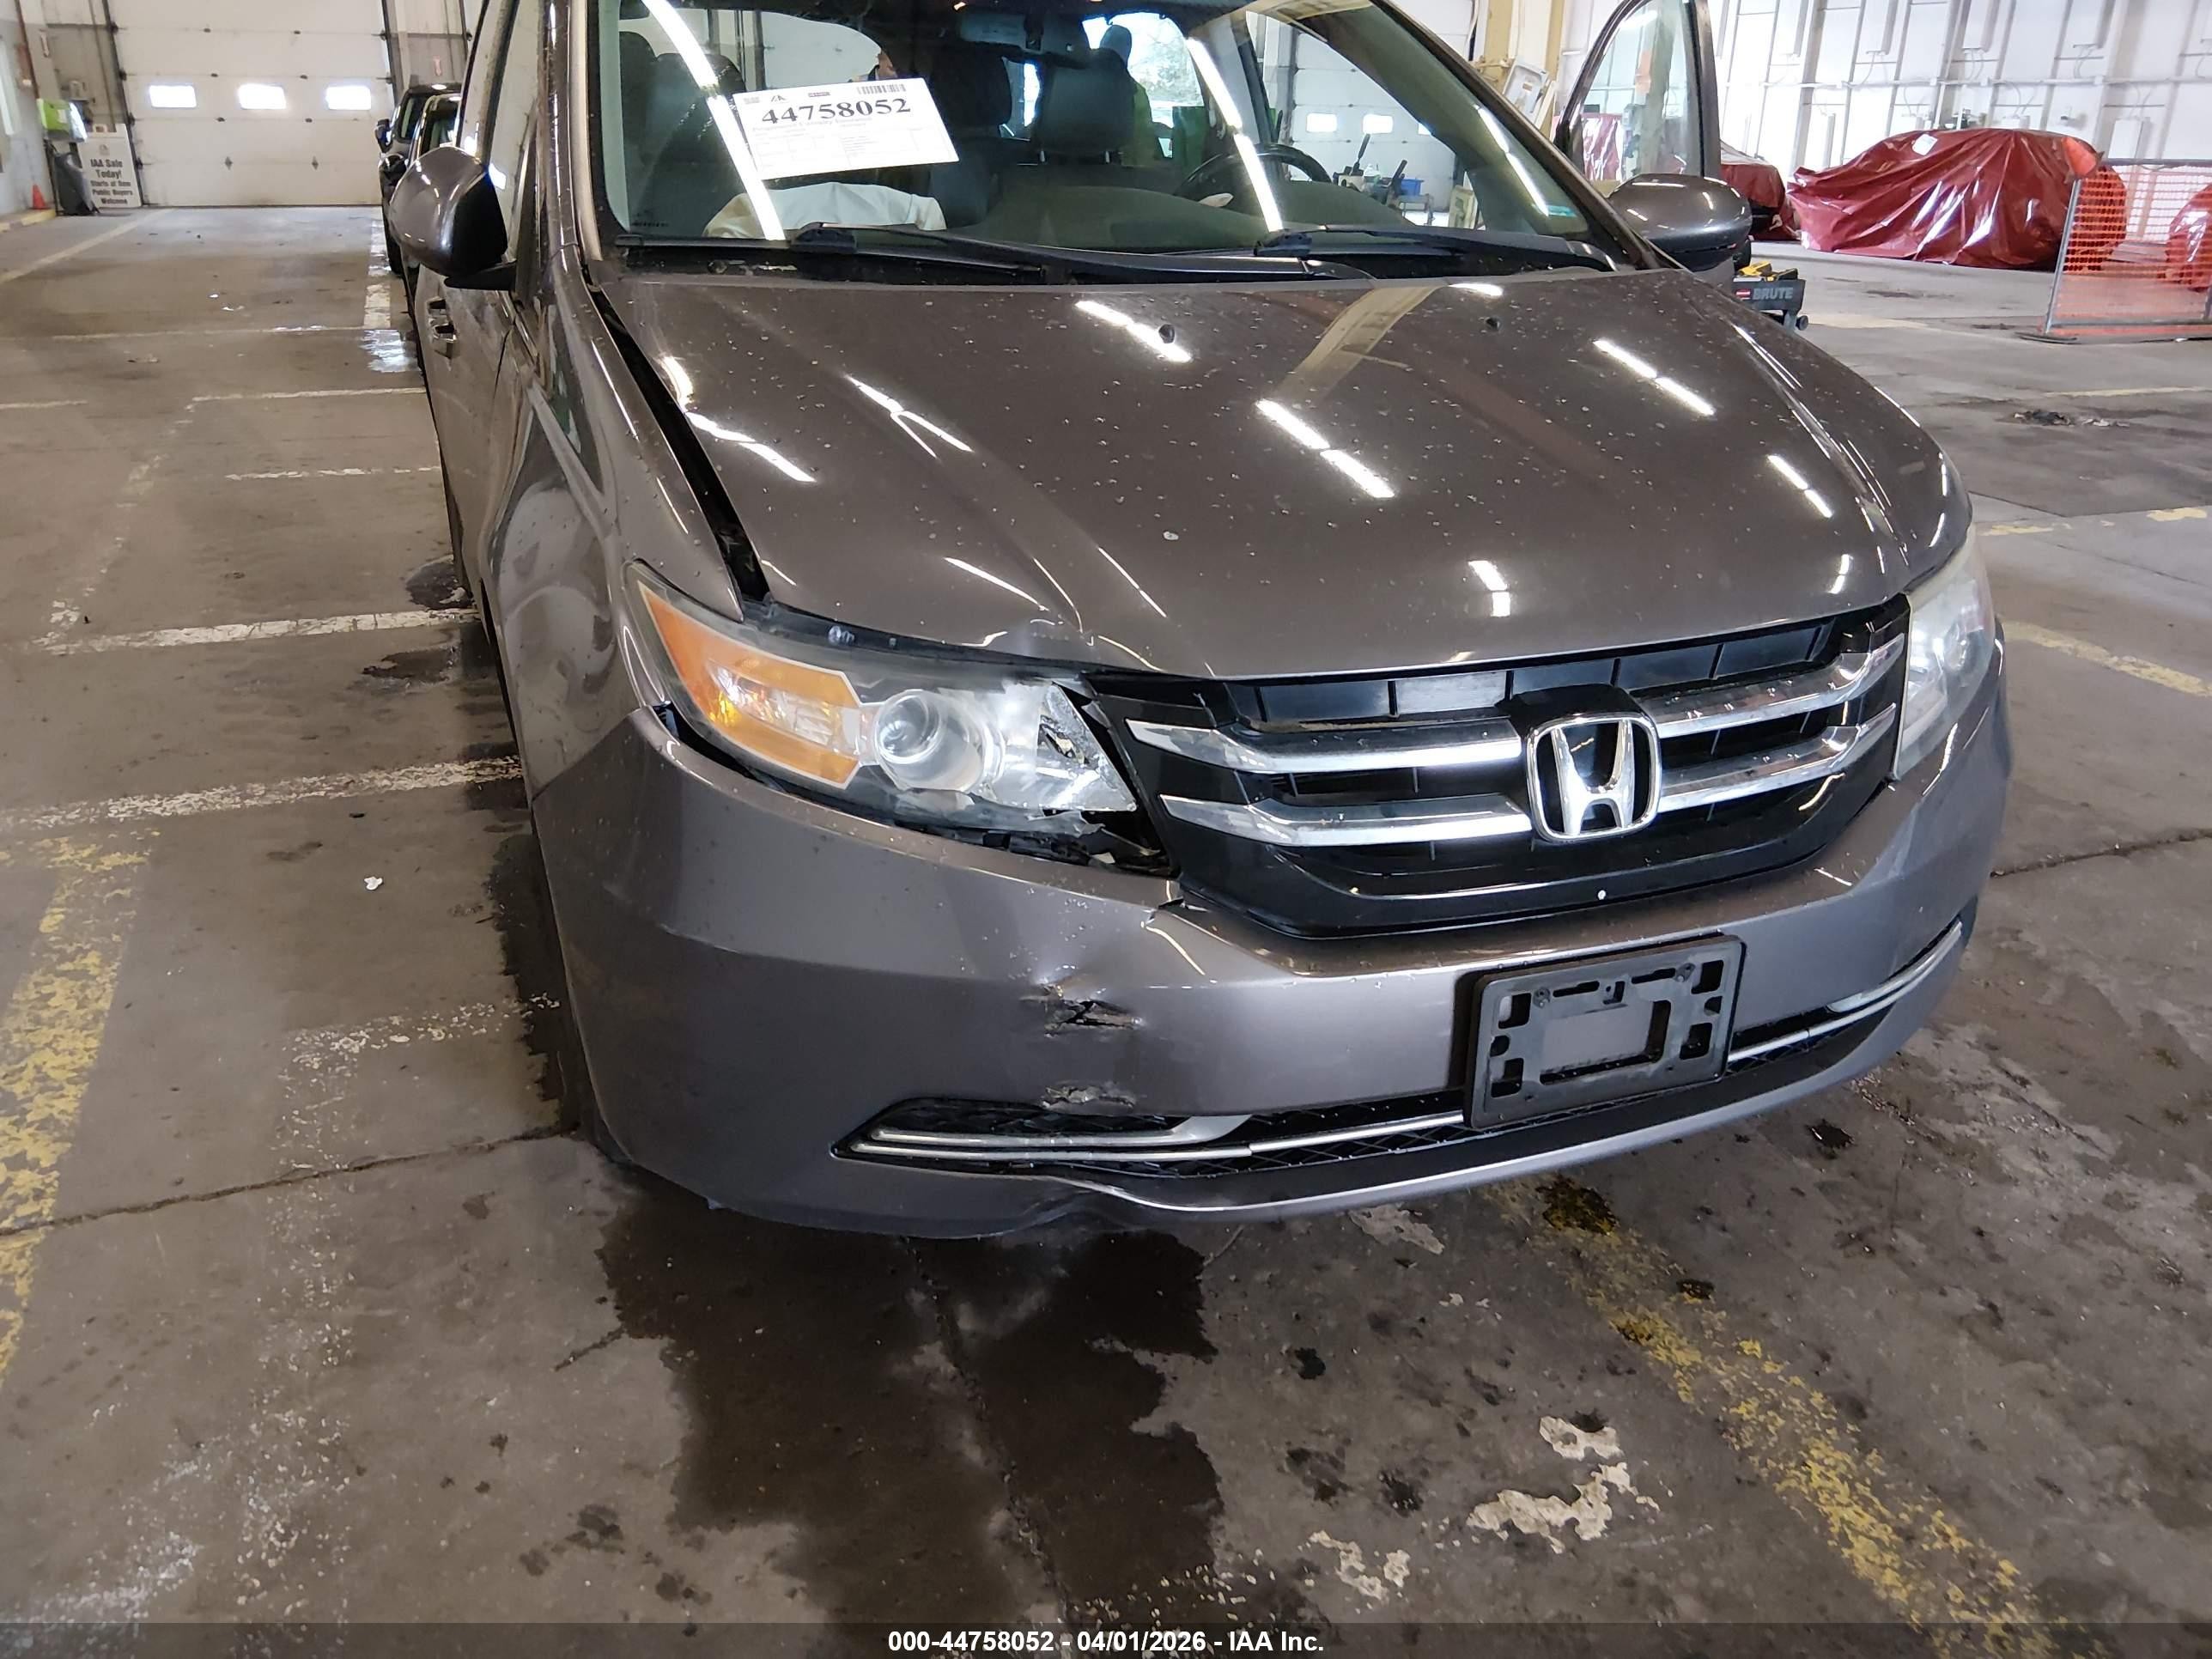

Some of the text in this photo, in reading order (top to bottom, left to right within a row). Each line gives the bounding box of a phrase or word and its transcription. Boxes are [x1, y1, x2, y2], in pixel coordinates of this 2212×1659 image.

[762, 98, 911, 124] 44758052
[90, 158, 123, 167] IAA Sale
[95, 169, 121, 179] Today!
[1753, 287, 1794, 301] BRUTE
